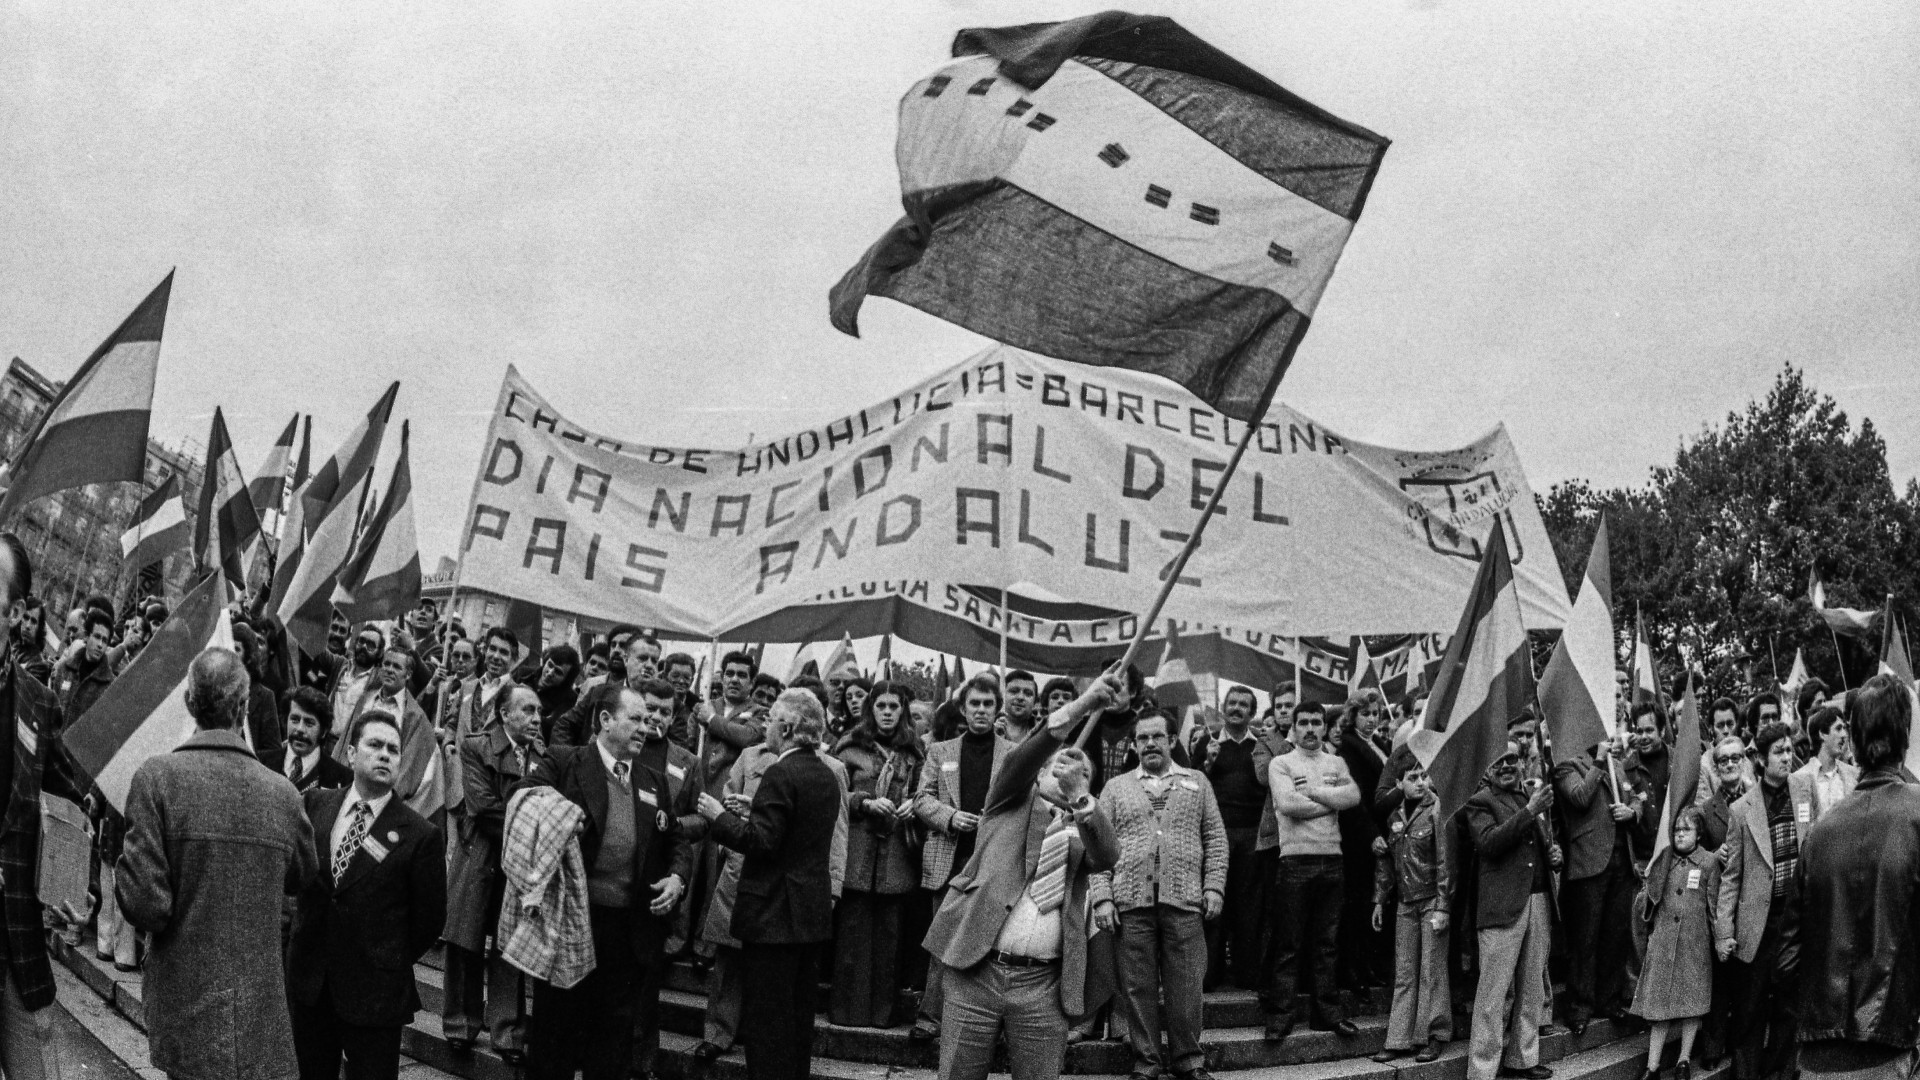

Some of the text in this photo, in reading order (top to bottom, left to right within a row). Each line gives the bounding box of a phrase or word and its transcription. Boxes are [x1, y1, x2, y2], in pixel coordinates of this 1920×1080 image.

[483, 413, 1290, 536] DIA NACIONAL DEL
[649, 448, 710, 474] DE
[467, 486, 1202, 595] PAIS ANDALUZ
[943, 583, 1073, 643] SANTA
